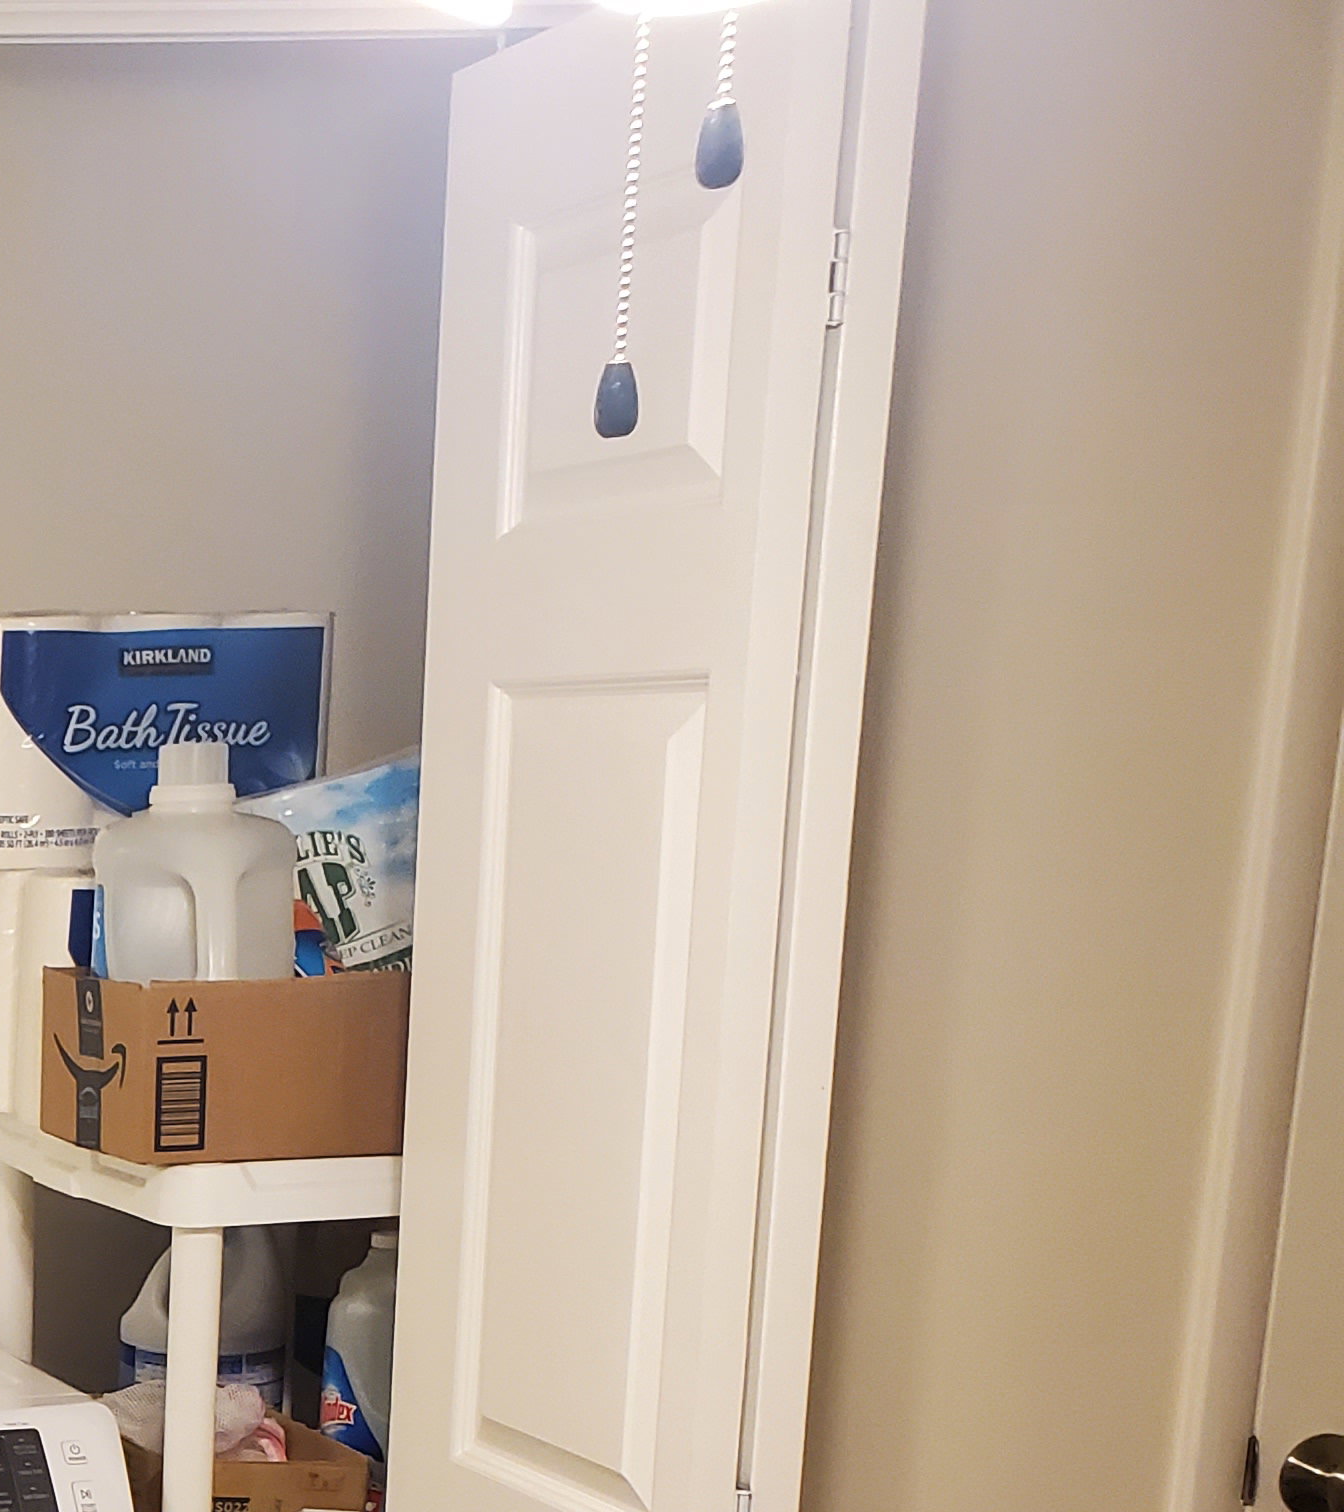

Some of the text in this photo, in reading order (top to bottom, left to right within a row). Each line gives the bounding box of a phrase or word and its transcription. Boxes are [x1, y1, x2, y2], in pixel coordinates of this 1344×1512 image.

[123, 648, 211, 665] KIRKLAND
[63, 702, 271, 753] Bath Tissue
[114, 759, 136, 770] Soft
